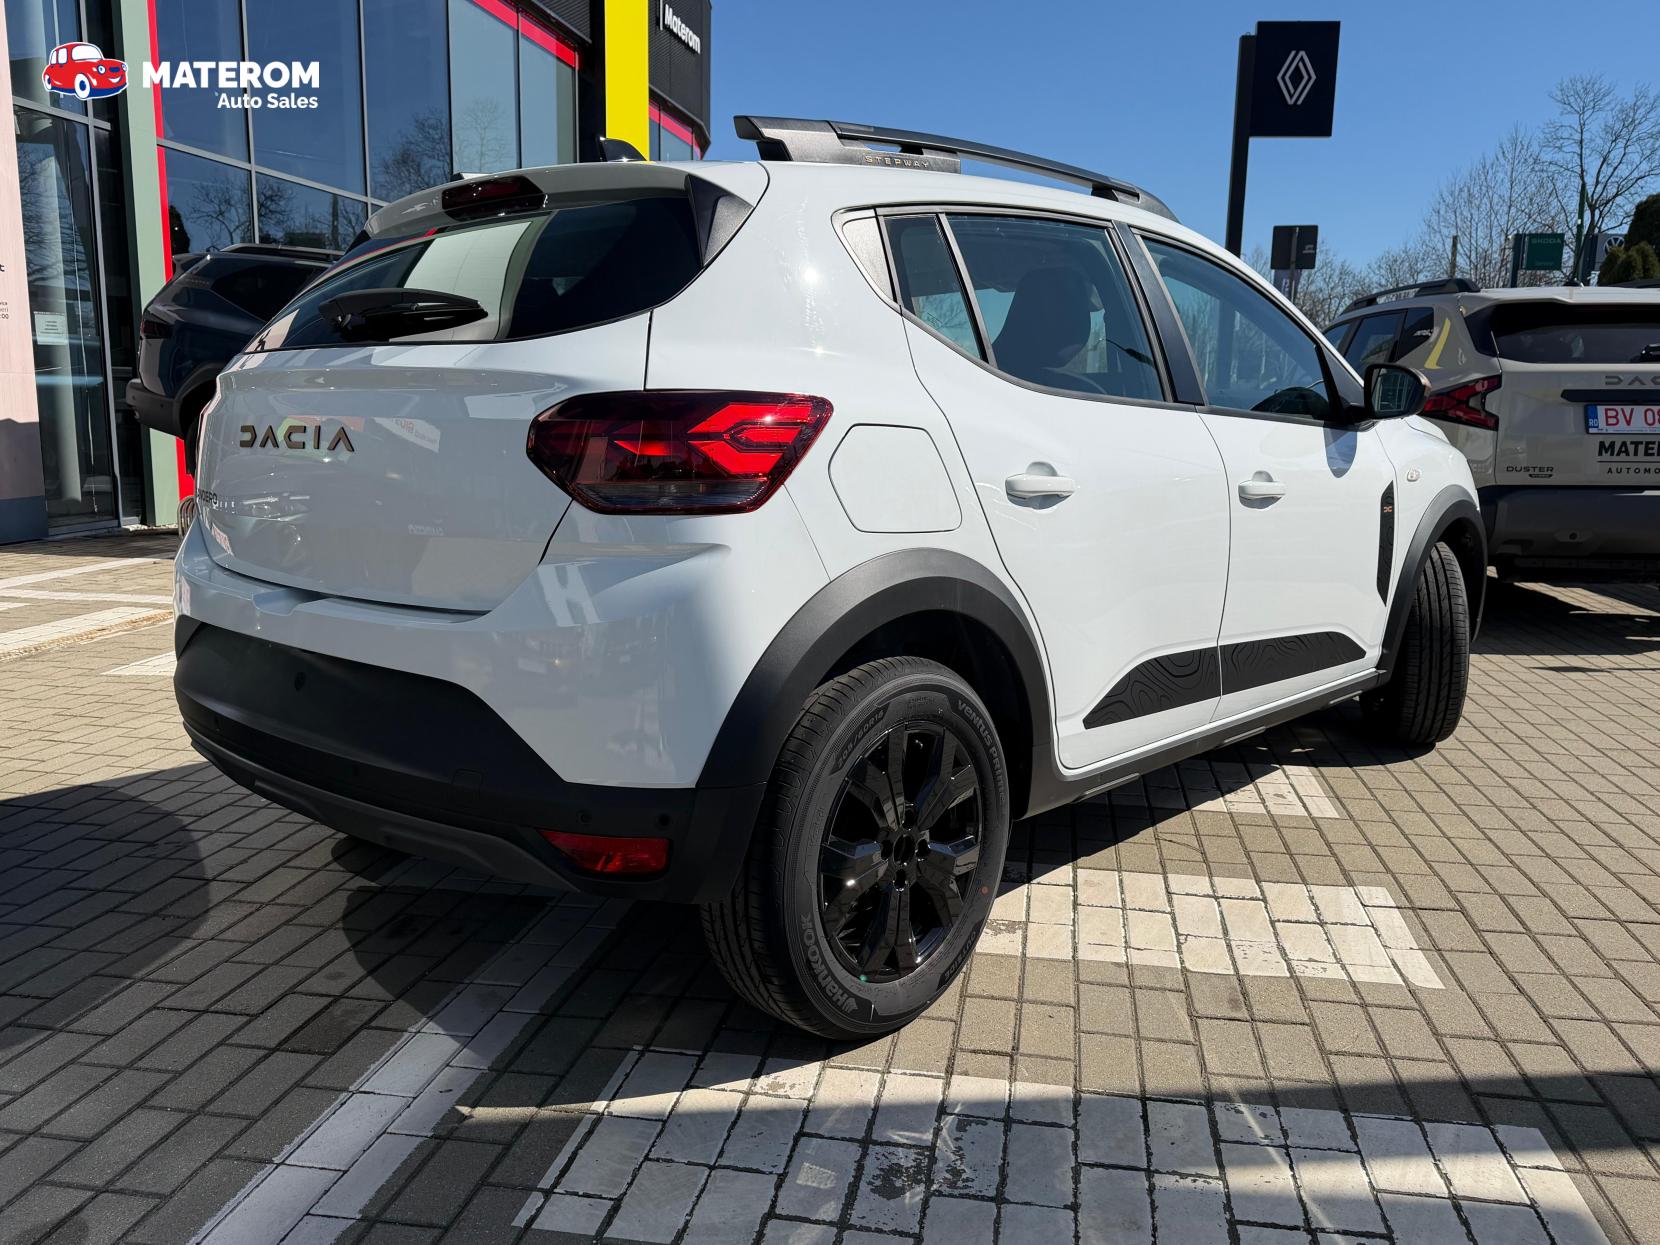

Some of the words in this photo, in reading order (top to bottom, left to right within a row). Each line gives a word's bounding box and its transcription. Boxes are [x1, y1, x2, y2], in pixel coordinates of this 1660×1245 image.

[664, 3, 701, 54] Materom
[864, 155, 929, 168] STEPWAY
[1604, 407, 1634, 427] BV
[239, 424, 355, 453] DACIA
[1597, 440, 1660, 457] MATE
[1505, 465, 1555, 473] DUSTER
